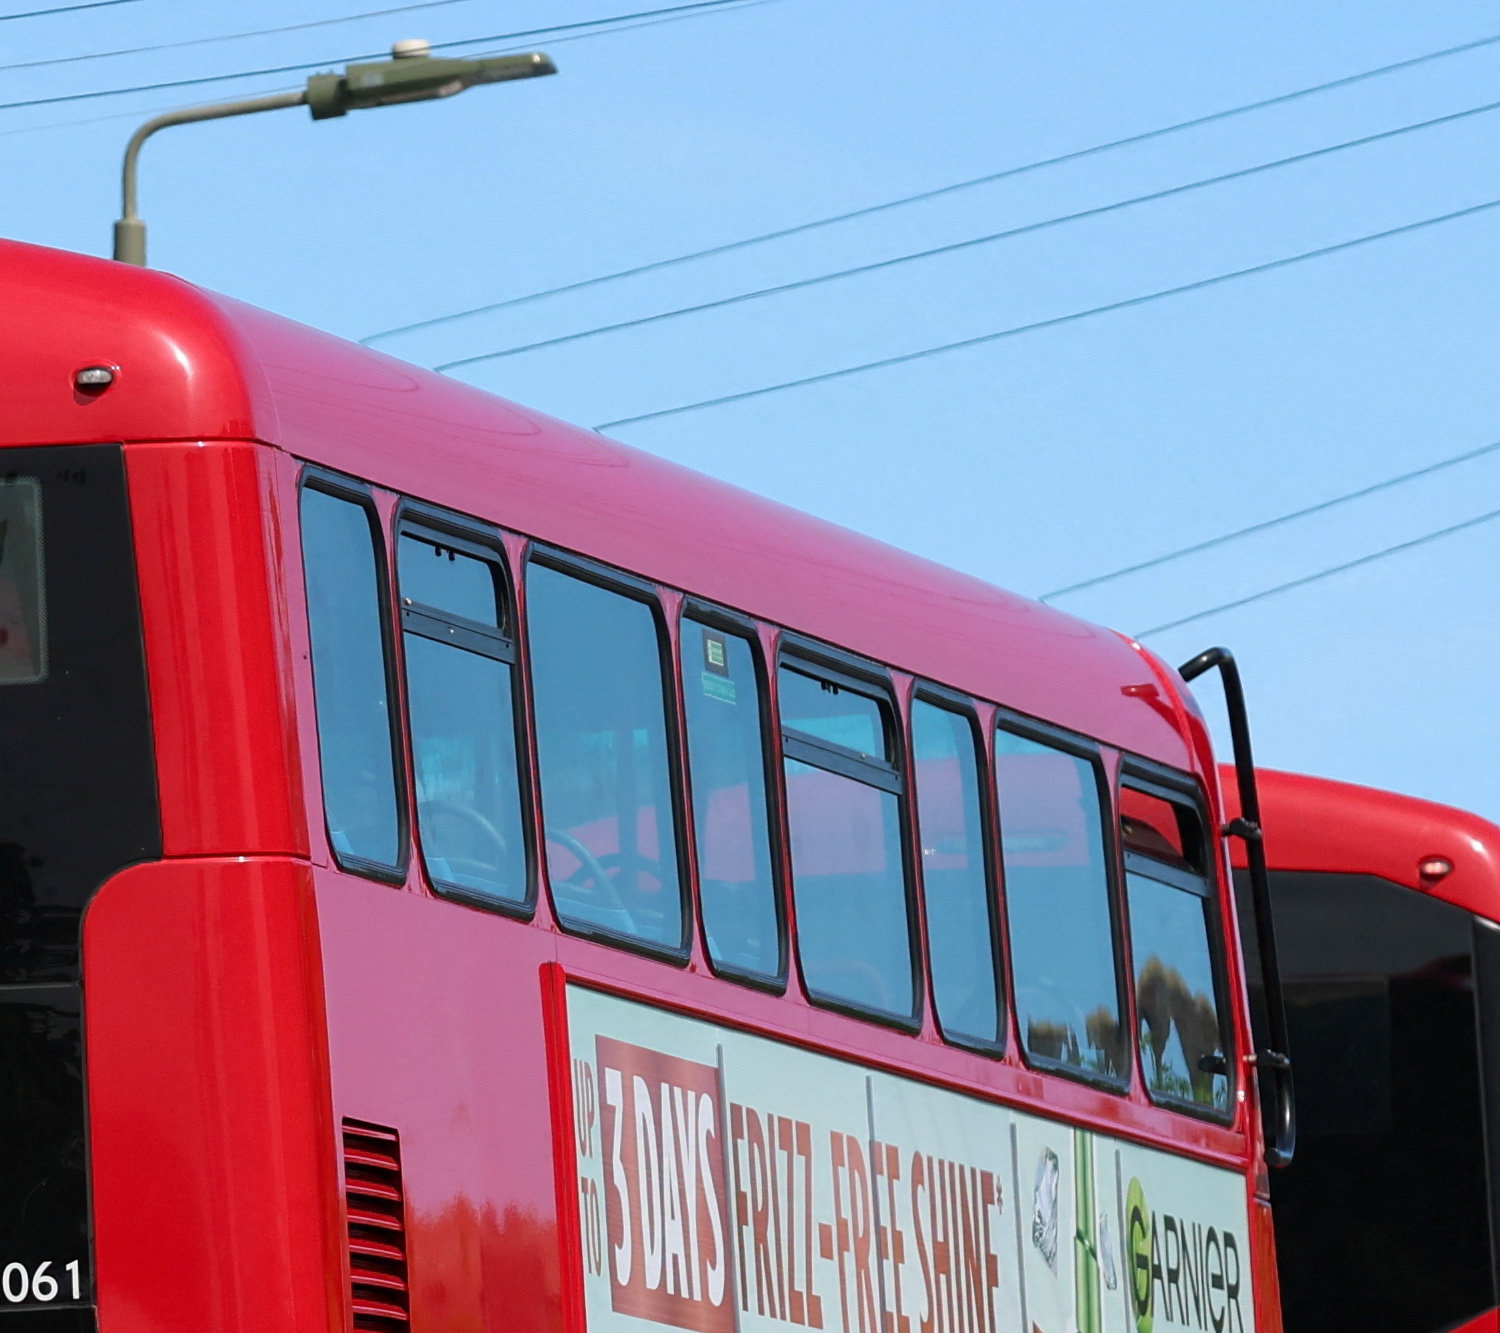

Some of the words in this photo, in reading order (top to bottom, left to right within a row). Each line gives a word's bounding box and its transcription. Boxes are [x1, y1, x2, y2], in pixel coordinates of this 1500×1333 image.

[573, 1057, 595, 1159] UP
[581, 1176, 601, 1277] TO
[604, 1066, 632, 1287] 3
[632, 1074, 725, 1308] DAYS
